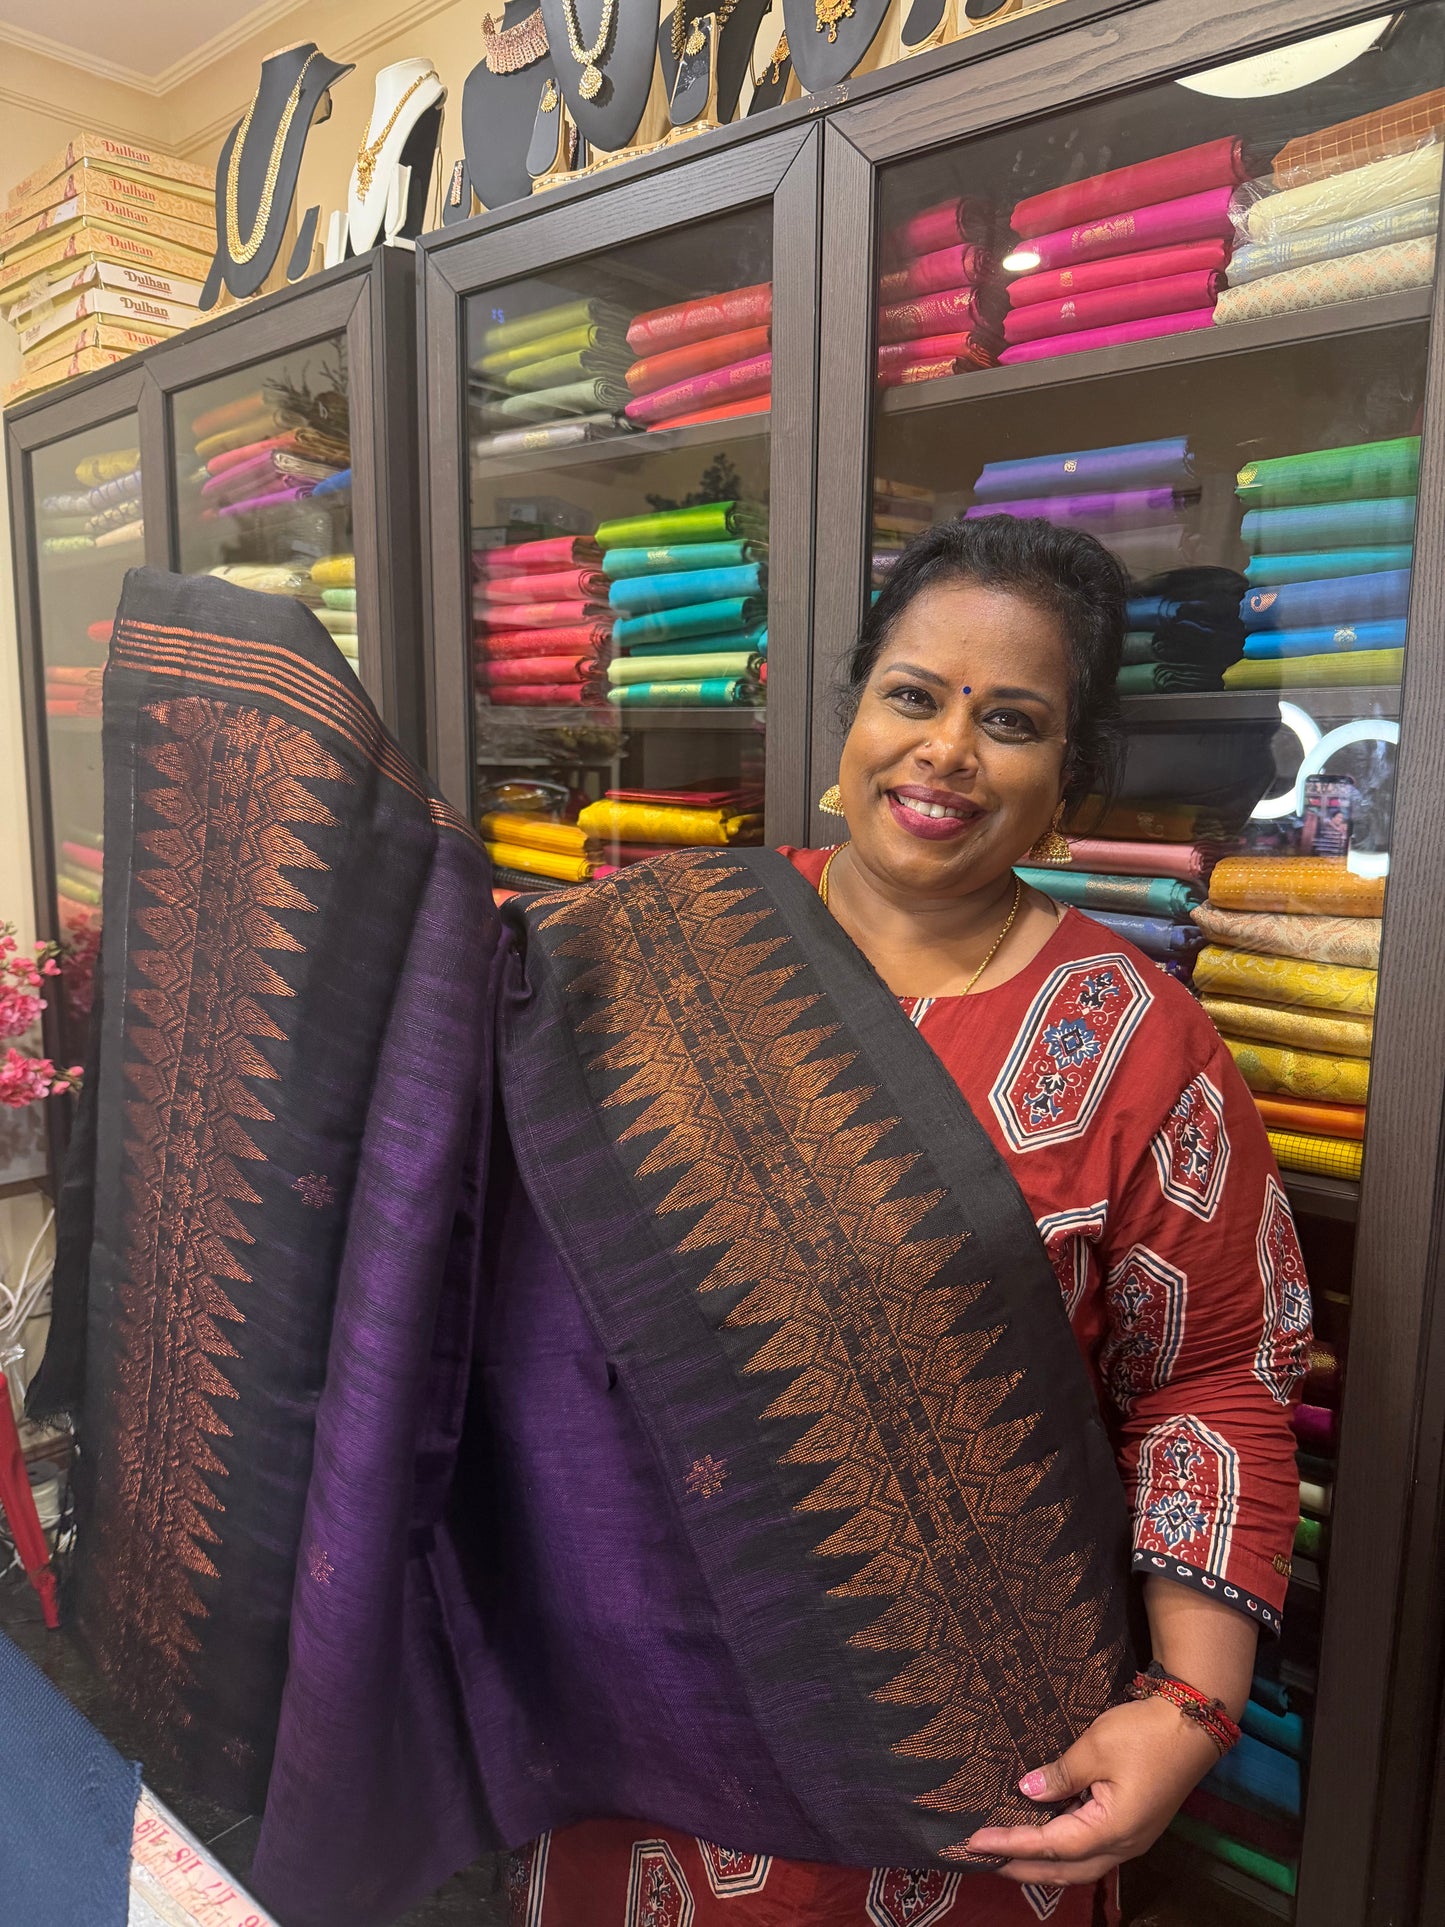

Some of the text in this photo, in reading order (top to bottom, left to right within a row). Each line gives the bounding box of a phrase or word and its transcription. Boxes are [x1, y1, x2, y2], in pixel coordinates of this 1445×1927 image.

[101, 139, 151, 162] Dulhan
[108, 178, 156, 201] Dulhan
[101, 199, 149, 223] Dulhan
[106, 234, 154, 257] Dulhan
[124, 270, 171, 291] Dulhan
[120, 297, 169, 317] Dulhan
[123, 331, 161, 346] Dulh
[135, 1819, 169, 1844] 19
[169, 1847, 203, 1874] 18
[201, 1882, 238, 1906] 17
